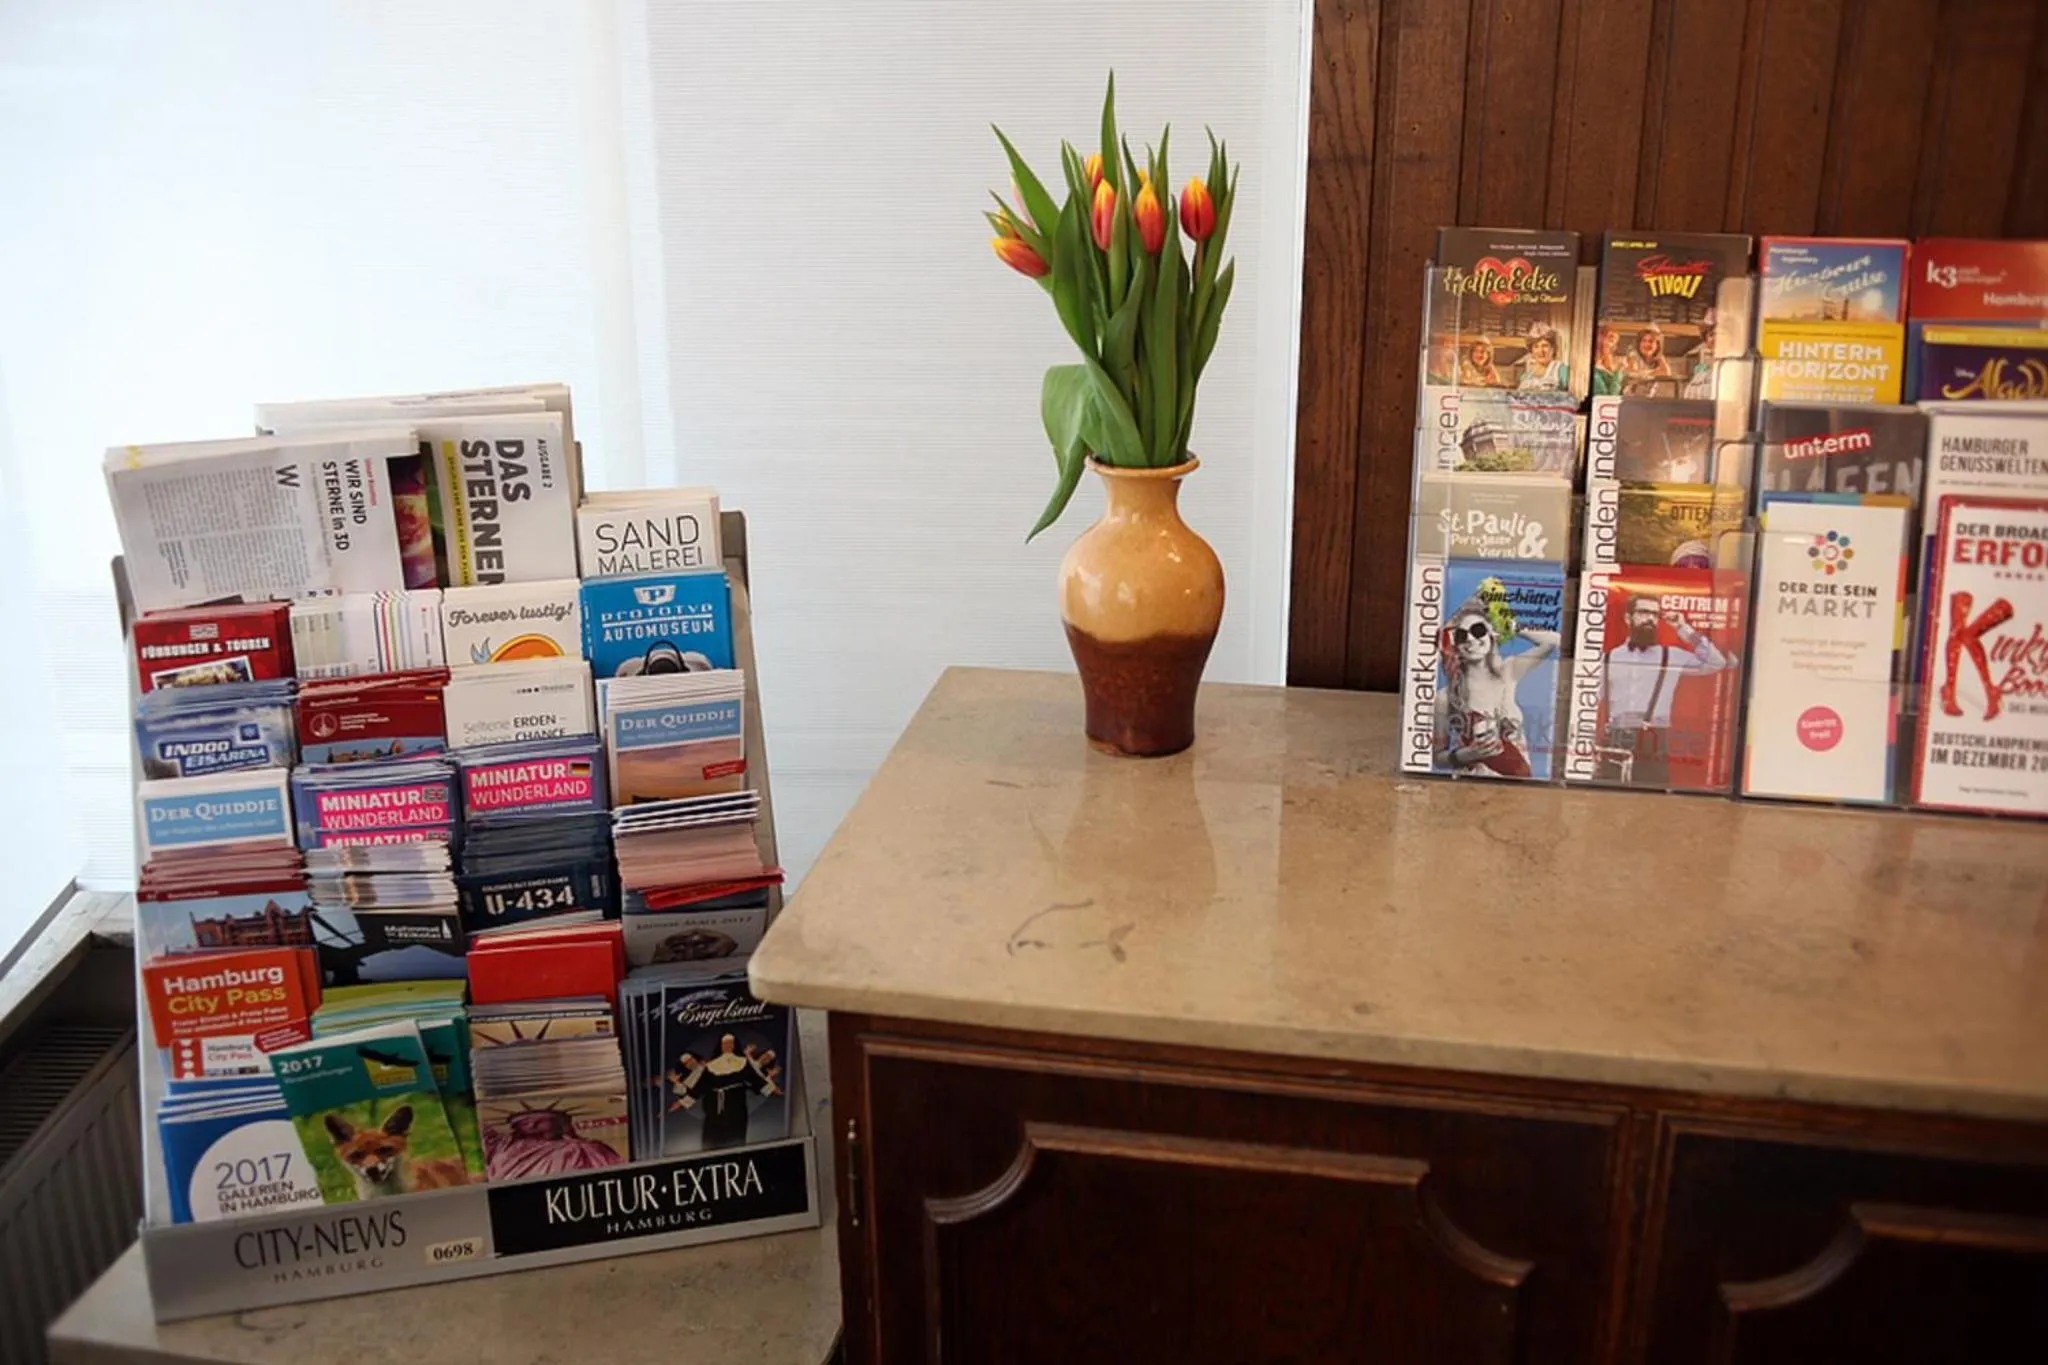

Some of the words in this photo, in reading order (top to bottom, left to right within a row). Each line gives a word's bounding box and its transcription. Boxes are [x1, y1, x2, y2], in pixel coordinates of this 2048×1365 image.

[1643, 275, 1703, 299] TIVOLI
[1779, 341, 1883, 361] HINTERM
[1769, 360, 1889, 381] HORIZONT
[1783, 432, 1871, 458] unterm
[1942, 436, 2029, 457] HAMBURGER
[345, 459, 362, 489] WIR
[495, 440, 531, 502] DAS
[1940, 455, 2048, 475] GENUSSWELTEN
[323, 461, 344, 515] STERNE
[335, 533, 350, 550] 3D
[350, 491, 367, 524] SIND
[595, 515, 699, 554] SAND
[1467, 510, 1527, 537] Pauli
[1956, 523, 1990, 537] DER
[599, 547, 703, 575] MALEREI
[1954, 538, 2048, 568] ERFO
[1778, 581, 1808, 595] DER
[1813, 582, 1838, 596] DIE
[1843, 585, 1878, 597] SEIN
[448, 609, 517, 628] Forever
[520, 602, 573, 621] lustig!
[1777, 597, 1878, 618] MARKT
[603, 620, 715, 642] AUTOMUSEUM
[226, 638, 270, 652] TOUREN
[1405, 566, 1442, 769] heimatkunden
[1567, 572, 1609, 780] heimatkunden
[620, 718, 657, 731] DER
[186, 749, 266, 768] EISARENA
[1931, 749, 1948, 765] IM
[1953, 750, 2027, 772] DEZEMBER
[471, 763, 566, 788] MINIATUR
[322, 790, 420, 812] MINIATUR
[473, 781, 588, 805] WUNDERLAND
[151, 808, 193, 822] DER
[324, 807, 443, 829] WUNDERLAND
[484, 885, 575, 915] U-434
[163, 966, 284, 995] Hamburg
[168, 991, 219, 1015] City
[227, 985, 287, 1007] Pass
[278, 1055, 323, 1074] 2017
[214, 1152, 292, 1190] 2017
[217, 1180, 295, 1202] GALERIEN
[219, 1199, 237, 1213] IN
[240, 1187, 322, 1211] HAMBURG
[606, 1208, 713, 1235] HAMBURG
[234, 1210, 407, 1270] CITY-NEWS
[432, 1242, 474, 1261] 0698
[274, 1259, 385, 1283] HAMBURG
